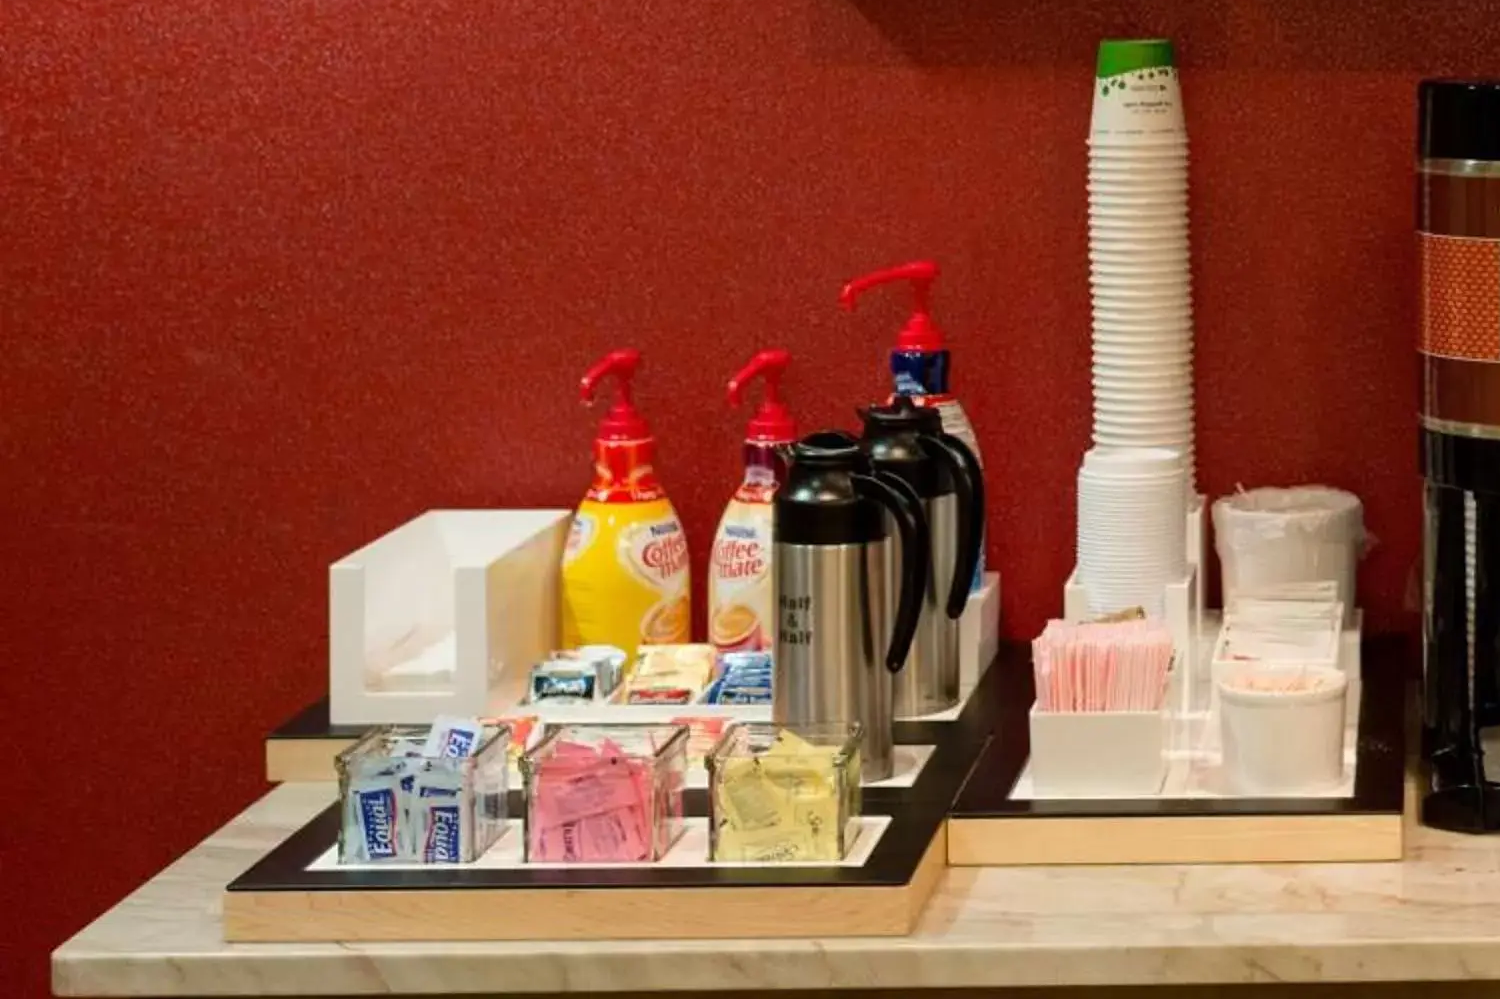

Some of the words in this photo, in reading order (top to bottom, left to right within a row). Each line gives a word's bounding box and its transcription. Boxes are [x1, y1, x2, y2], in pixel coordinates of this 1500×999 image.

[787, 612, 799, 628] &
[367, 794, 393, 855] Equal
[434, 810, 453, 861] Equa
